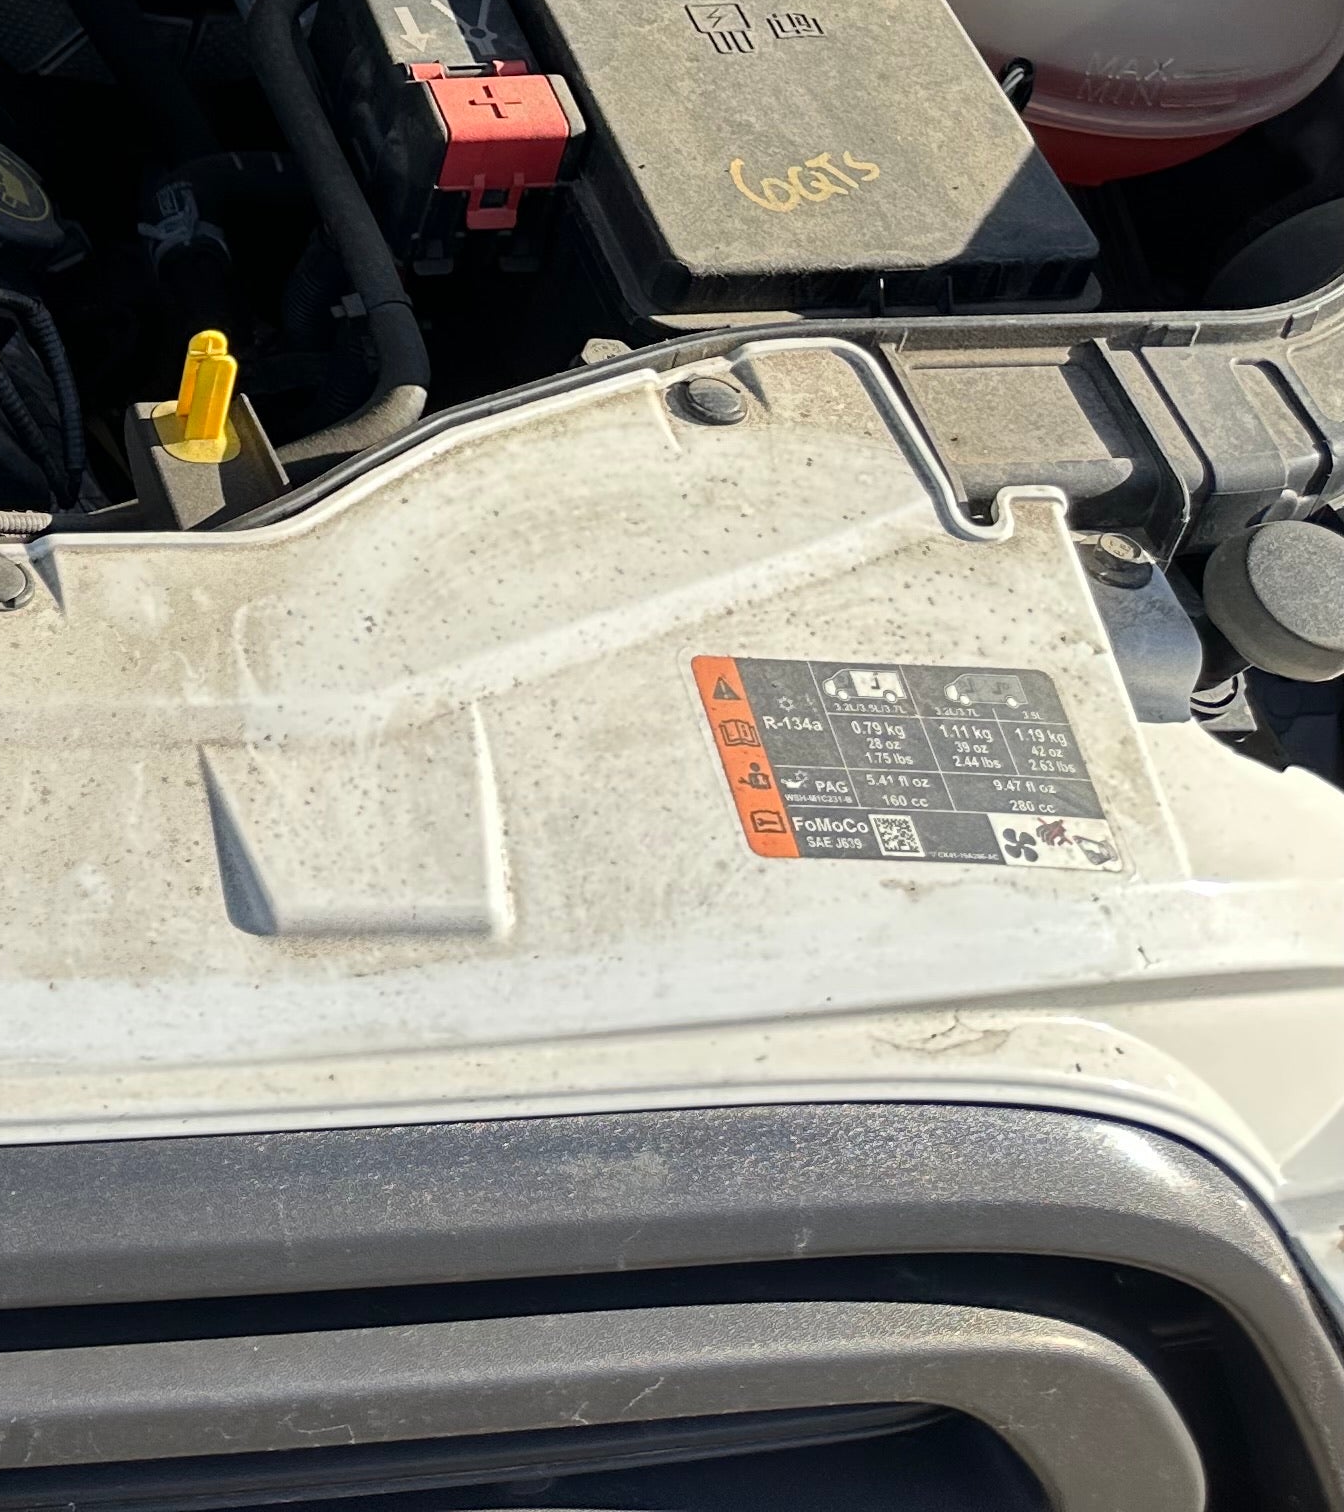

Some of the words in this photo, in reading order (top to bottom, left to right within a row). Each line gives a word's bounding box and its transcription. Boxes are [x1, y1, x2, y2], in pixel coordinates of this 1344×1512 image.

[762, 716, 823, 732] R-134a
[850, 721, 882, 736] 0.79
[884, 722, 905, 739] kg
[939, 725, 969, 739] 1.11
[972, 726, 993, 743] kg
[1015, 727, 1045, 742] 1.19
[1047, 730, 1068, 747] kg
[867, 738, 883, 750] 28
[886, 740, 901, 750] oz
[954, 741, 970, 753] 39
[973, 744, 989, 754] oz
[865, 752, 891, 765] 1.75
[892, 753, 913, 765] lbs
[1031, 745, 1046, 757] 42
[1048, 748, 1063, 758] oz
[952, 755, 980, 768] 2.44
[981, 757, 1002, 769] lbs
[1028, 759, 1055, 772] 2.63
[1056, 761, 1076, 773] lbs
[814, 780, 849, 794] PAG
[866, 773, 895, 786] 5.41
[898, 775, 909, 787] fl
[912, 778, 931, 788] oz
[992, 779, 1021, 792] 9.47
[1025, 780, 1036, 793] fl
[1039, 785, 1057, 794] oz
[882, 794, 908, 807] 160
[911, 797, 929, 807] cc
[1009, 800, 1035, 812] 280
[1038, 803, 1056, 813] cc
[792, 816, 869, 834] FoMoCo
[806, 836, 833, 848] SAE
[835, 836, 863, 849] J639
